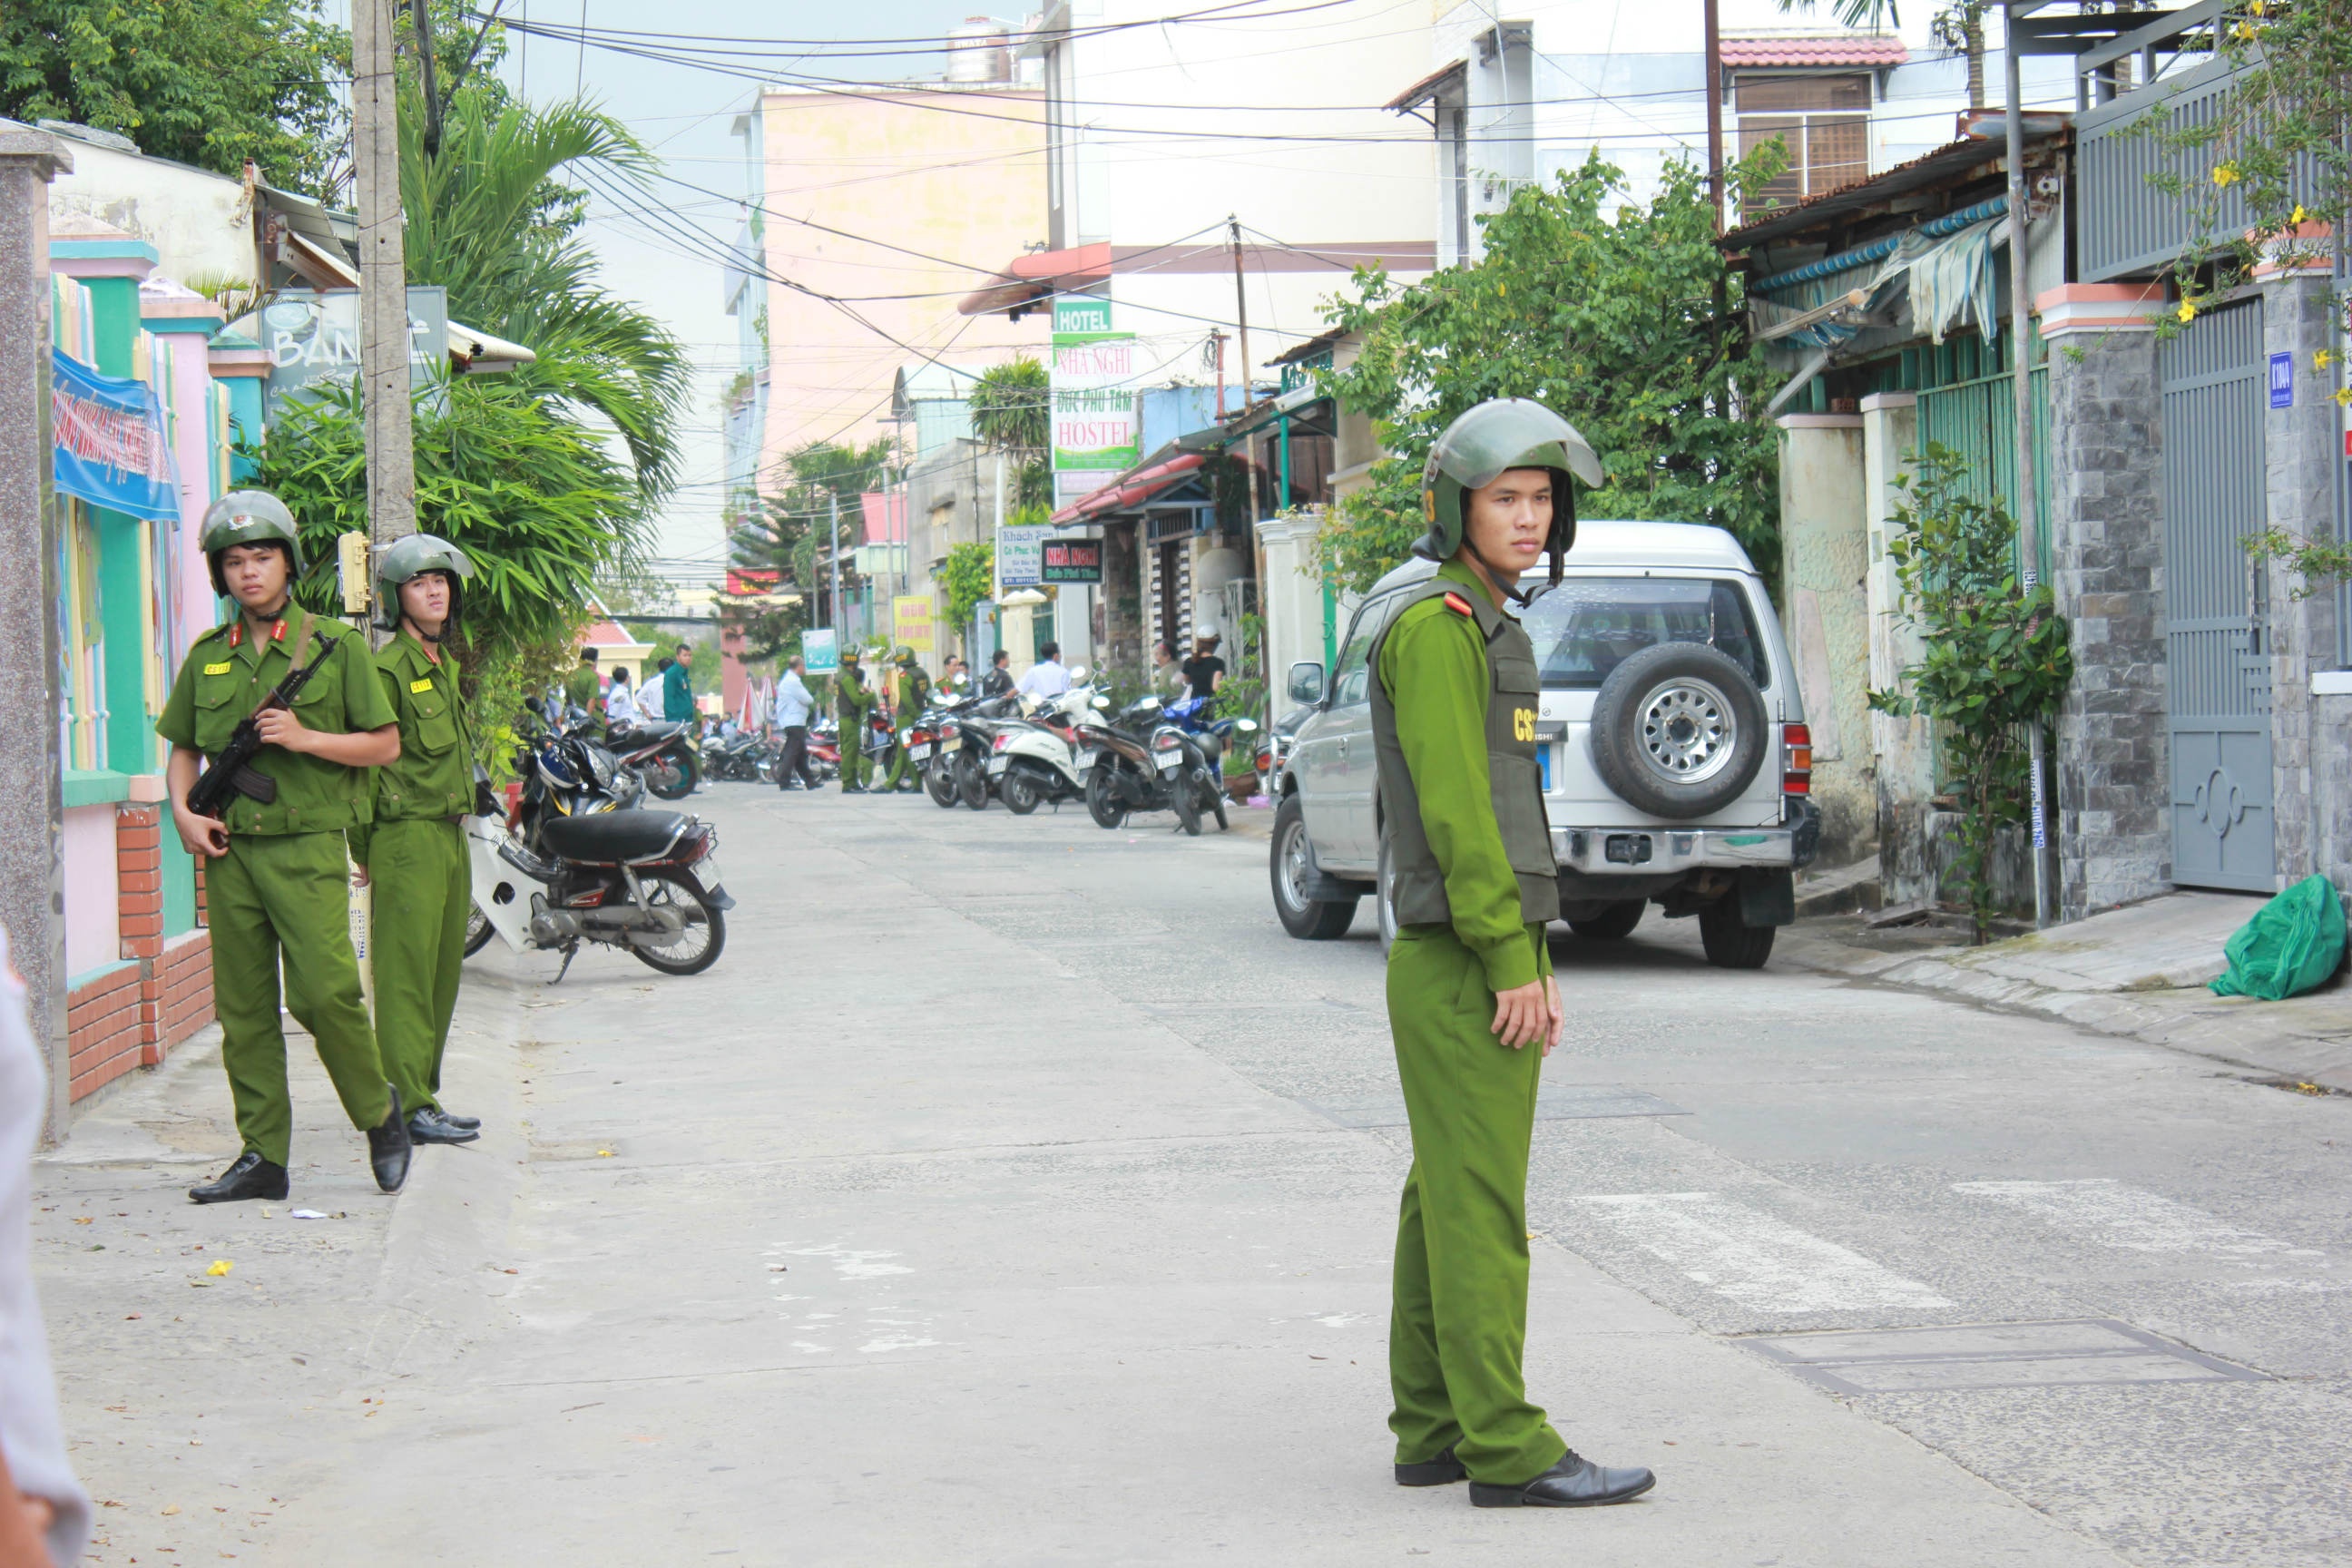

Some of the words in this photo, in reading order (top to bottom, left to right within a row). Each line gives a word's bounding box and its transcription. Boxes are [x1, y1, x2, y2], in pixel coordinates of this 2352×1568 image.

[1059, 310, 1108, 331] HOTEL
[1058, 422, 1133, 446] HOSTEL
[1047, 544, 1070, 566] NHÀ
